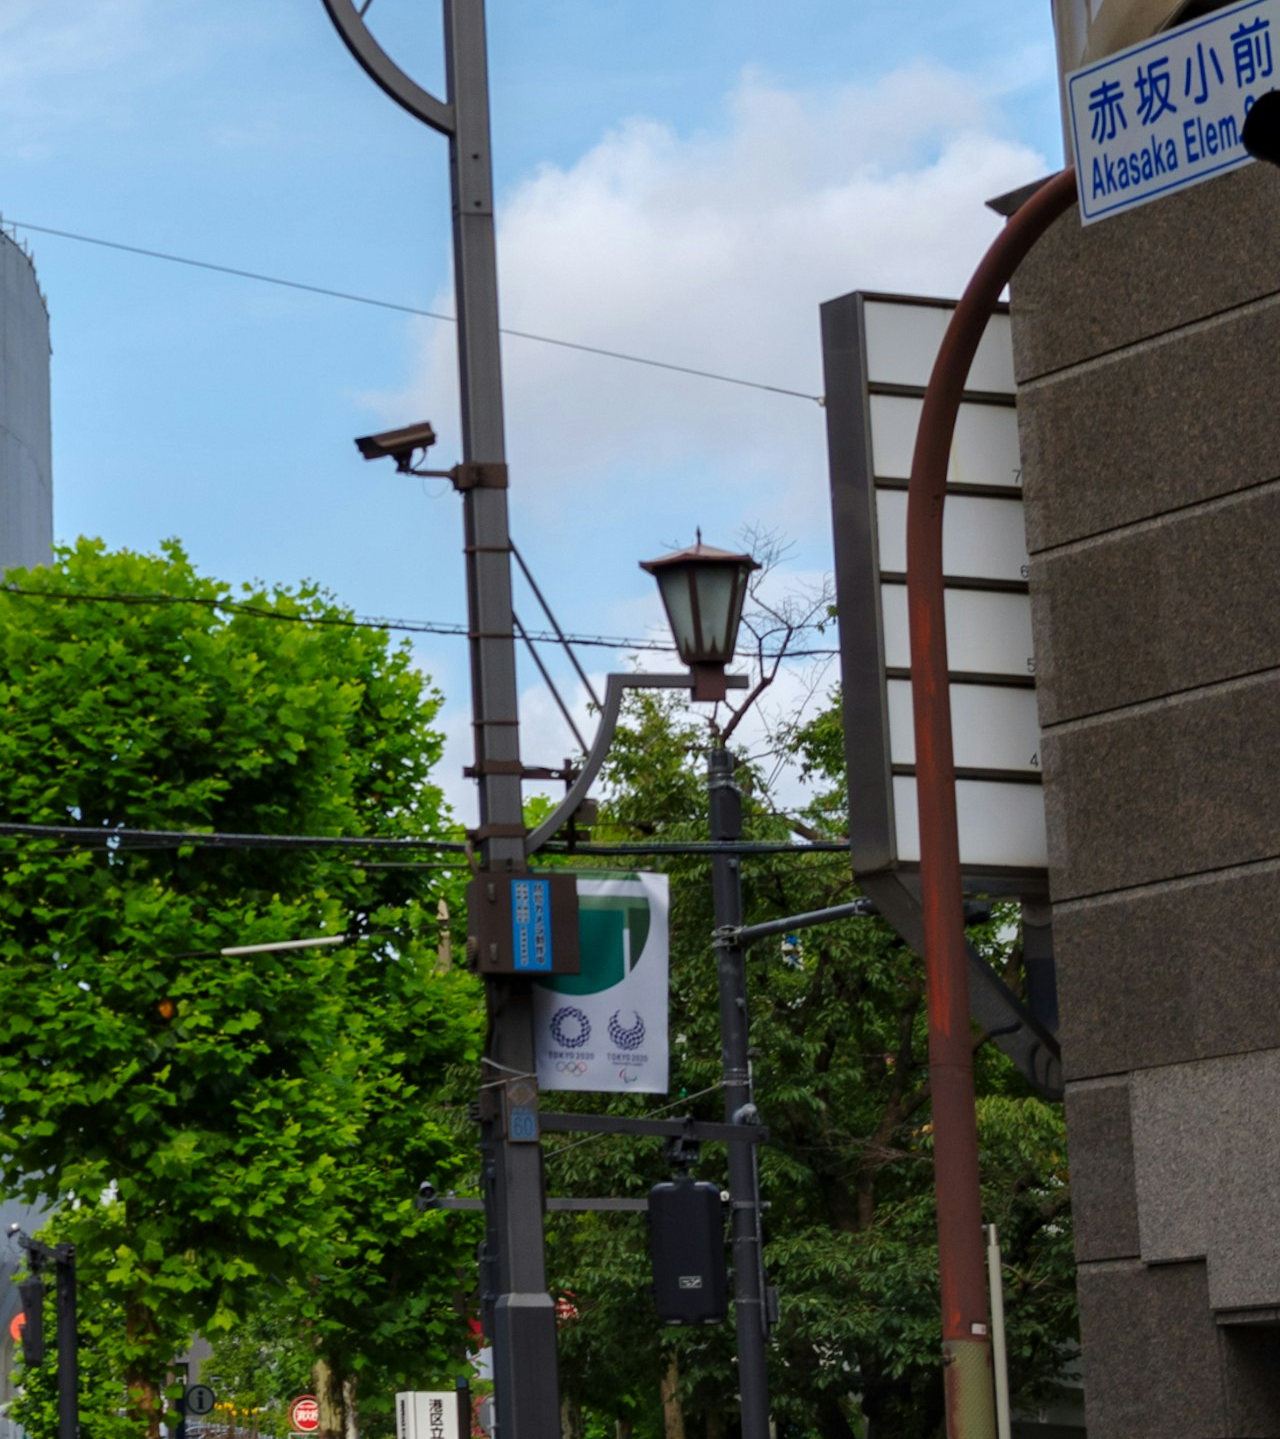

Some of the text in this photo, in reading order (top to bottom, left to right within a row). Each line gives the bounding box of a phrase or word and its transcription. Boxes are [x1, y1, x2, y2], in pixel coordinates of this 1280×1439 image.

[1088, 17, 1274, 145] 赤坂小前
[1092, 134, 1178, 200] Akasaka
[549, 1051, 595, 1060] TOKYO 2020
[631, 1054, 648, 1062] 2020
[513, 1117, 534, 1137] 60
